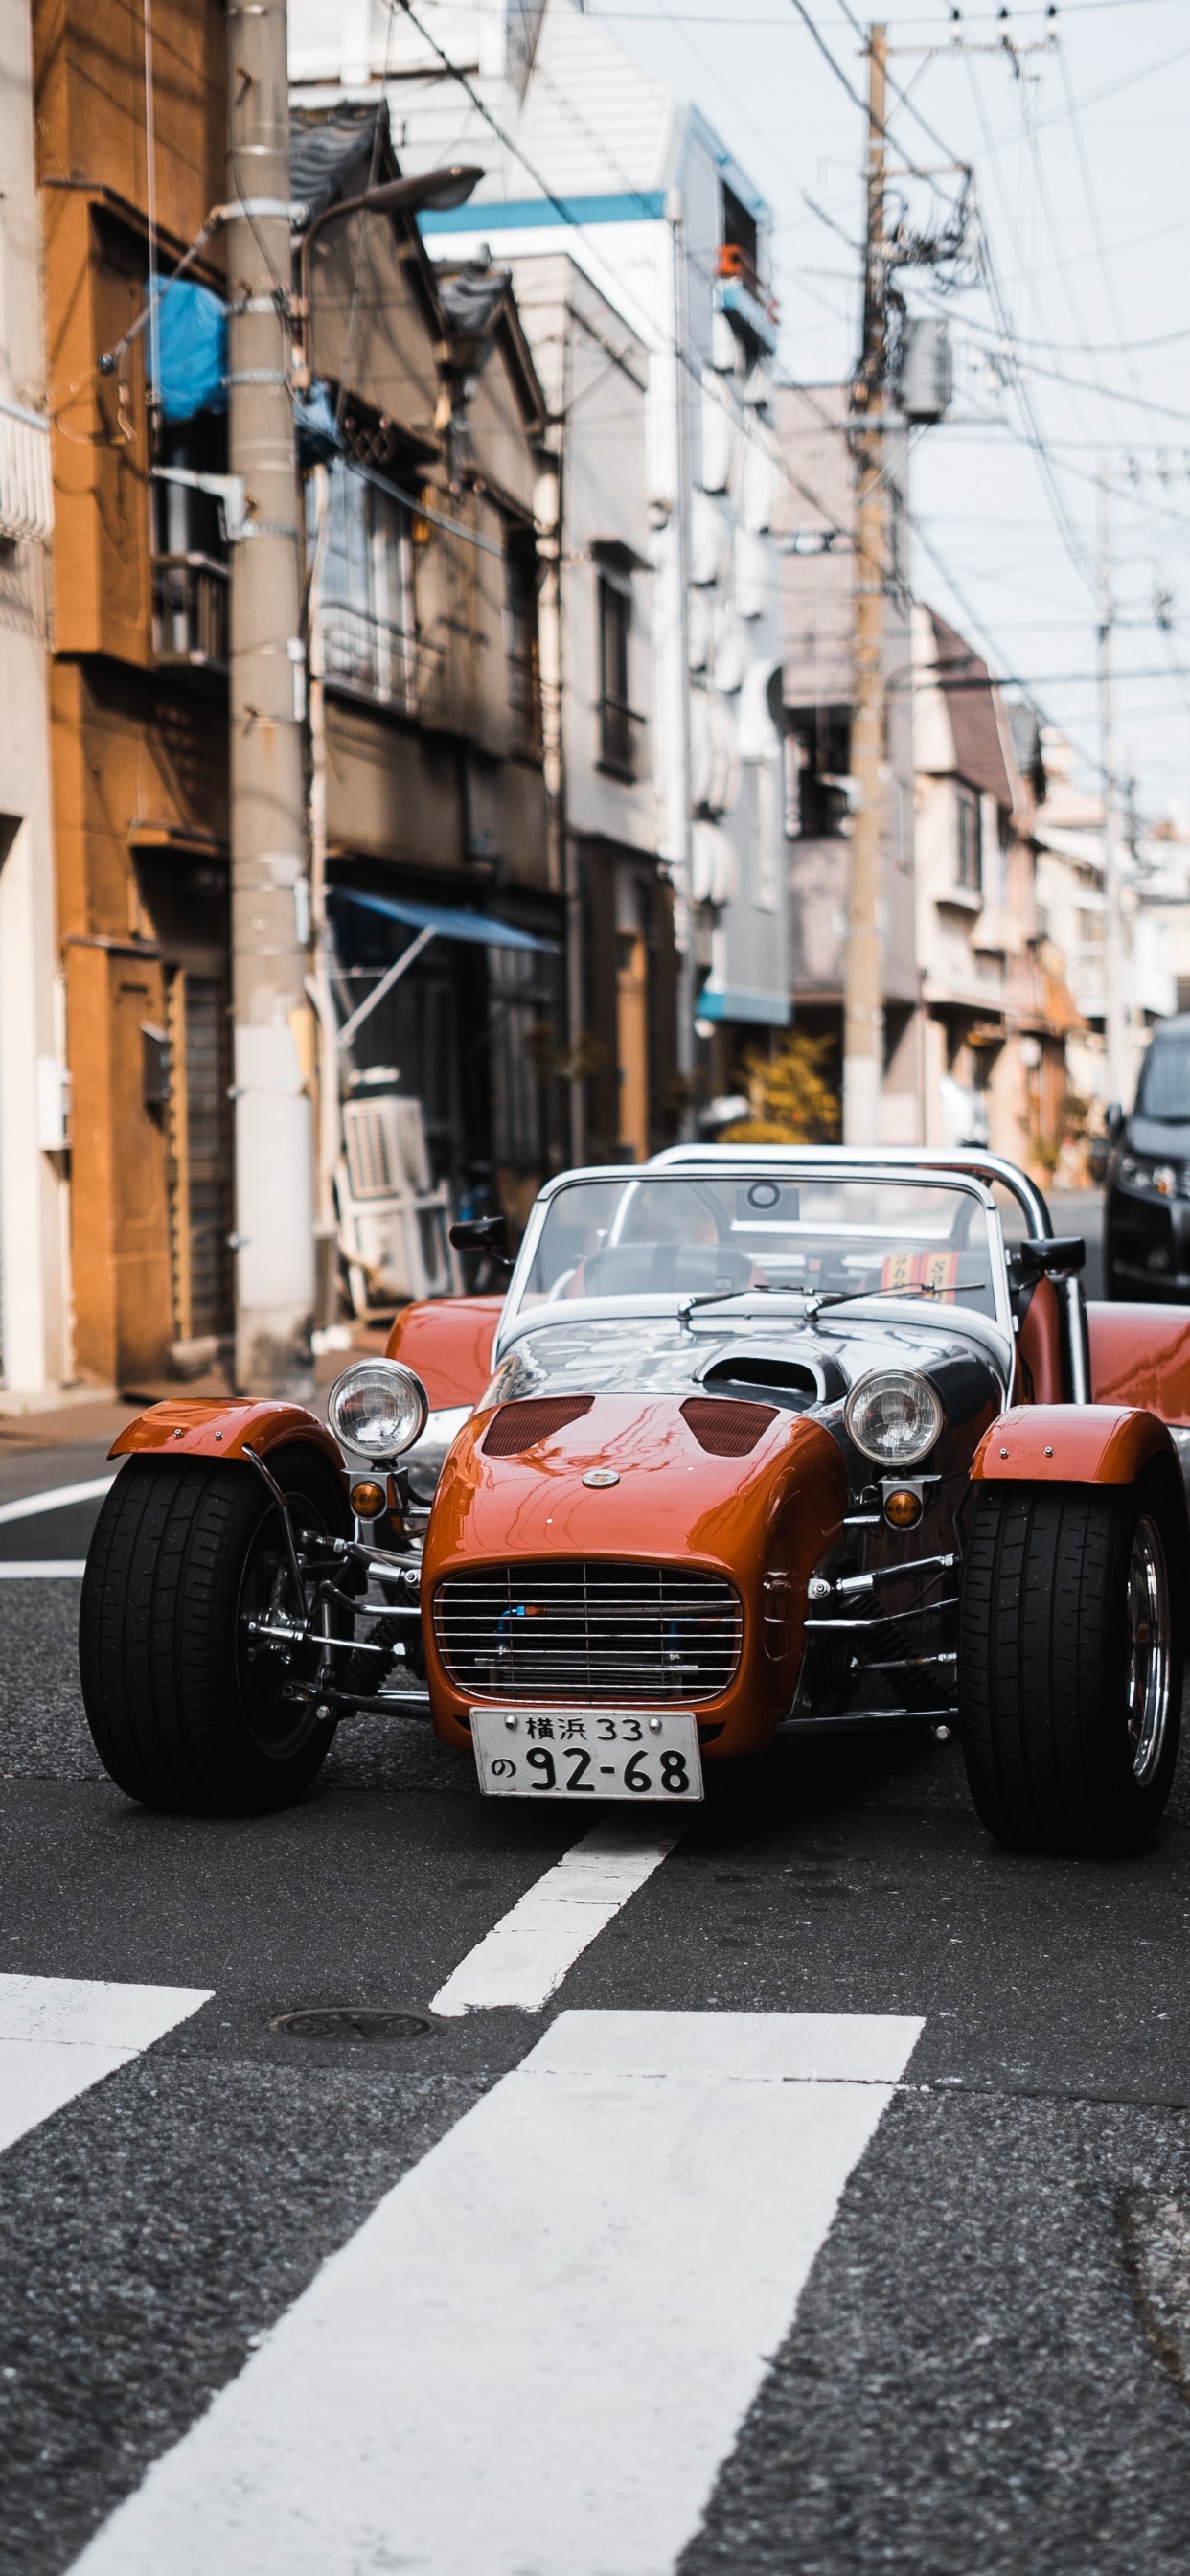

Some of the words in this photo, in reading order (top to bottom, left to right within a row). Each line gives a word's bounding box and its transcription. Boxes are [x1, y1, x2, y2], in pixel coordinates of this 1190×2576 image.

[526, 1716, 587, 1740] 横浜
[596, 1718, 643, 1741] 33
[491, 1758, 516, 1779] の
[525, 1746, 690, 1794] 92-68
